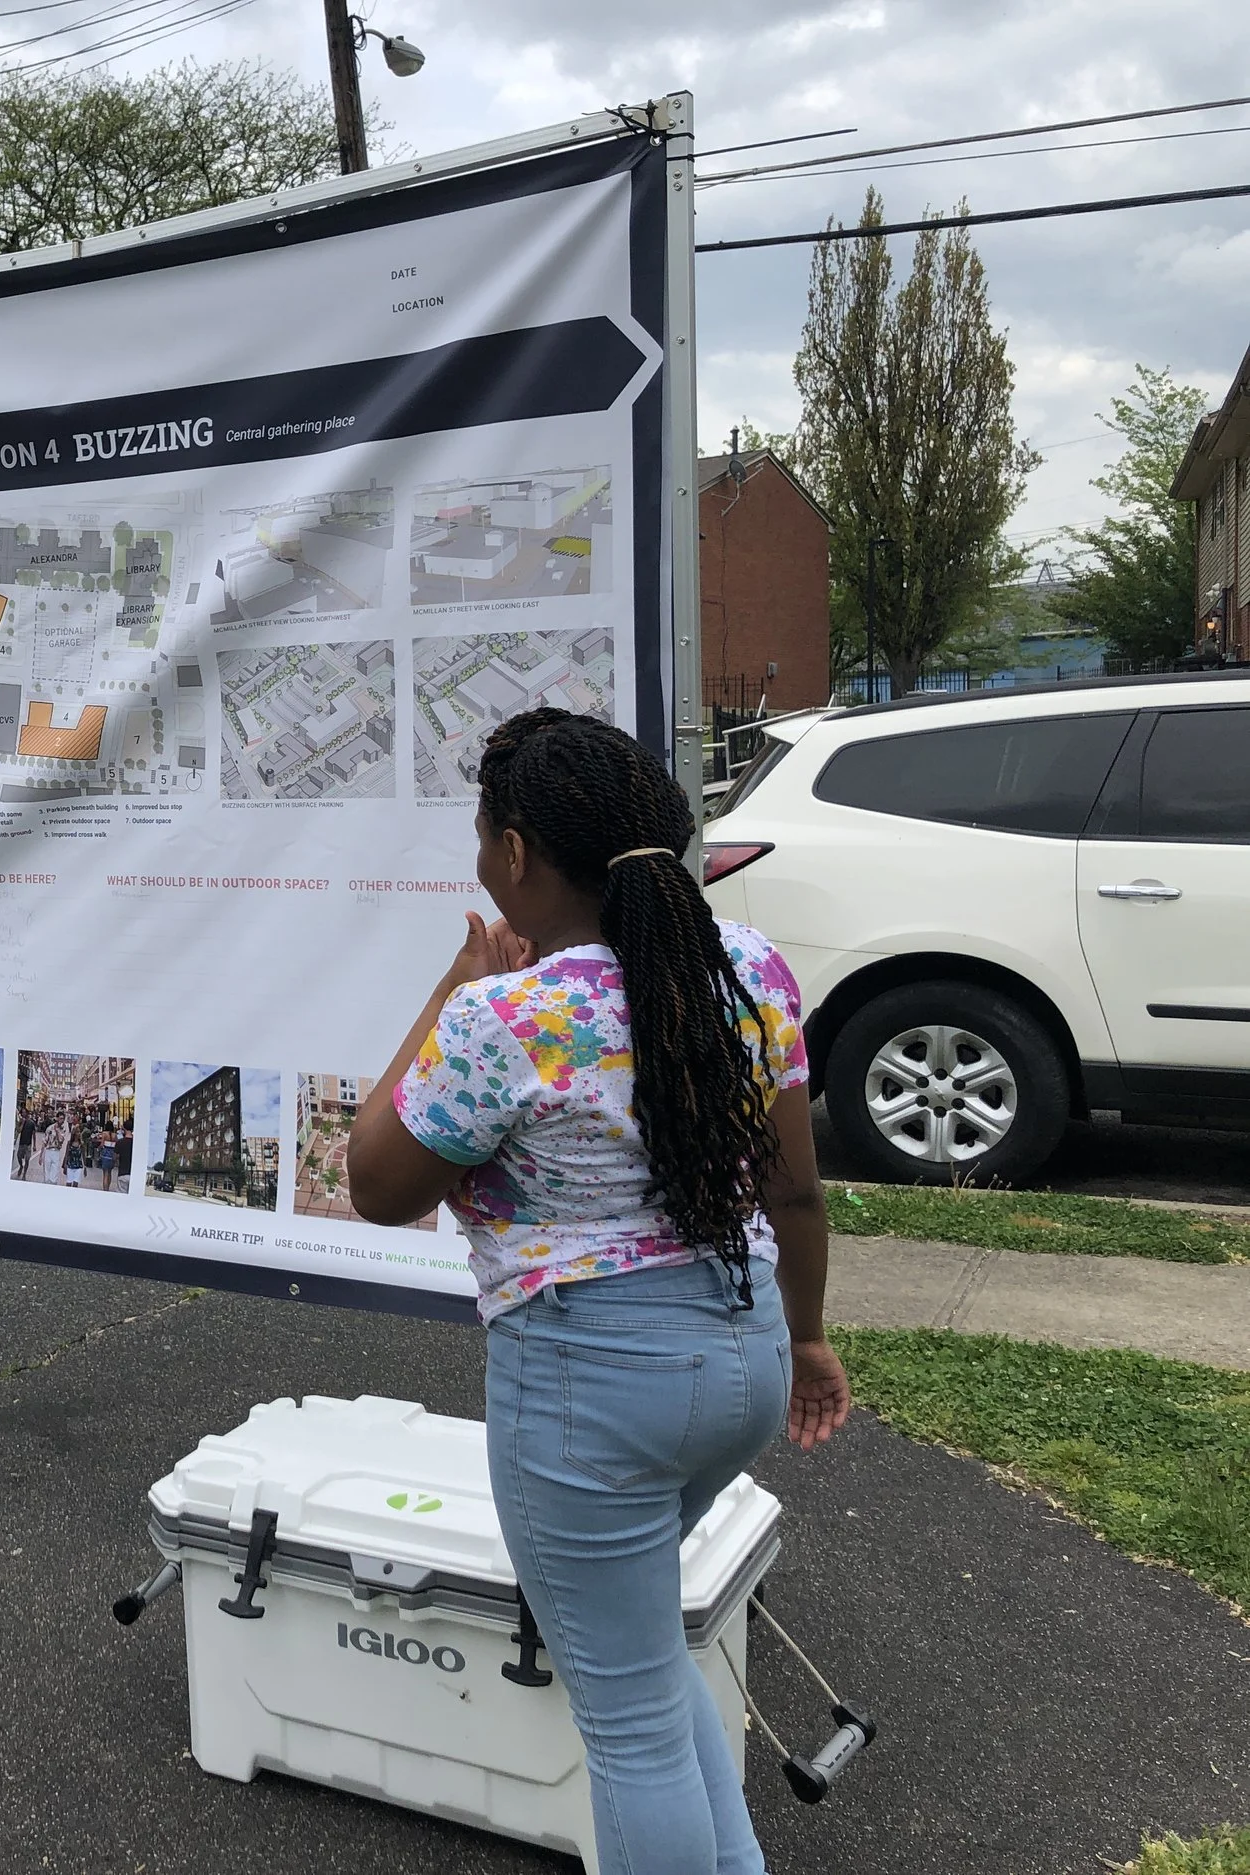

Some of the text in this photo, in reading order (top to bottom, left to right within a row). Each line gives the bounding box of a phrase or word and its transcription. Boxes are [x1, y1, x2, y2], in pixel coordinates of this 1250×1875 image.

[391, 267, 418, 281] DATE
[391, 296, 445, 314] LOCATION
[44, 441, 61, 465] 4
[72, 416, 215, 464] BUZZING
[225, 425, 265, 444] Central
[267, 418, 322, 442] gathering
[323, 414, 356, 435] place
[30, 553, 78, 564] ALEXANDRA
[126, 563, 161, 575] LIBRARY
[122, 604, 156, 615] LIBRARY
[413, 607, 448, 615] MCMILLAN
[449, 605, 472, 613] STREET
[491, 602, 521, 610] LOOKING
[116, 615, 160, 627] EXPANSION
[213, 624, 248, 633] MCMILLAN
[248, 620, 272, 628] STREET
[290, 616, 315, 624] LOOKING
[316, 614, 351, 622] NORTHWEST
[44, 627, 85, 637] OPTIONAL
[48, 637, 82, 648] GARAGE
[0, 644, 6, 654] 4
[0, 715, 14, 725] CVS
[63, 712, 69, 723] 4
[55, 736, 61, 747] 2
[134, 735, 141, 745] 7
[109, 768, 116, 779] 5
[160, 774, 167, 785] 5
[46, 806, 71, 814] Parking
[71, 804, 95, 812] beneath
[95, 803, 119, 811] building
[71, 817, 93, 825] outdoor
[51, 831, 77, 839] Improved
[9, 874, 23, 884] BE
[25, 874, 57, 885] HERE?
[106, 875, 330, 891] WHAT SHOULD BE IN OUTDOOR SPACE?
[348, 880, 482, 893] OTHER COMMENTS?
[190, 1226, 470, 1273] MARKER TIP! USE COLOR TO TELL US WHAT IS WORKIN
[337, 1622, 466, 1673] IGLOO
